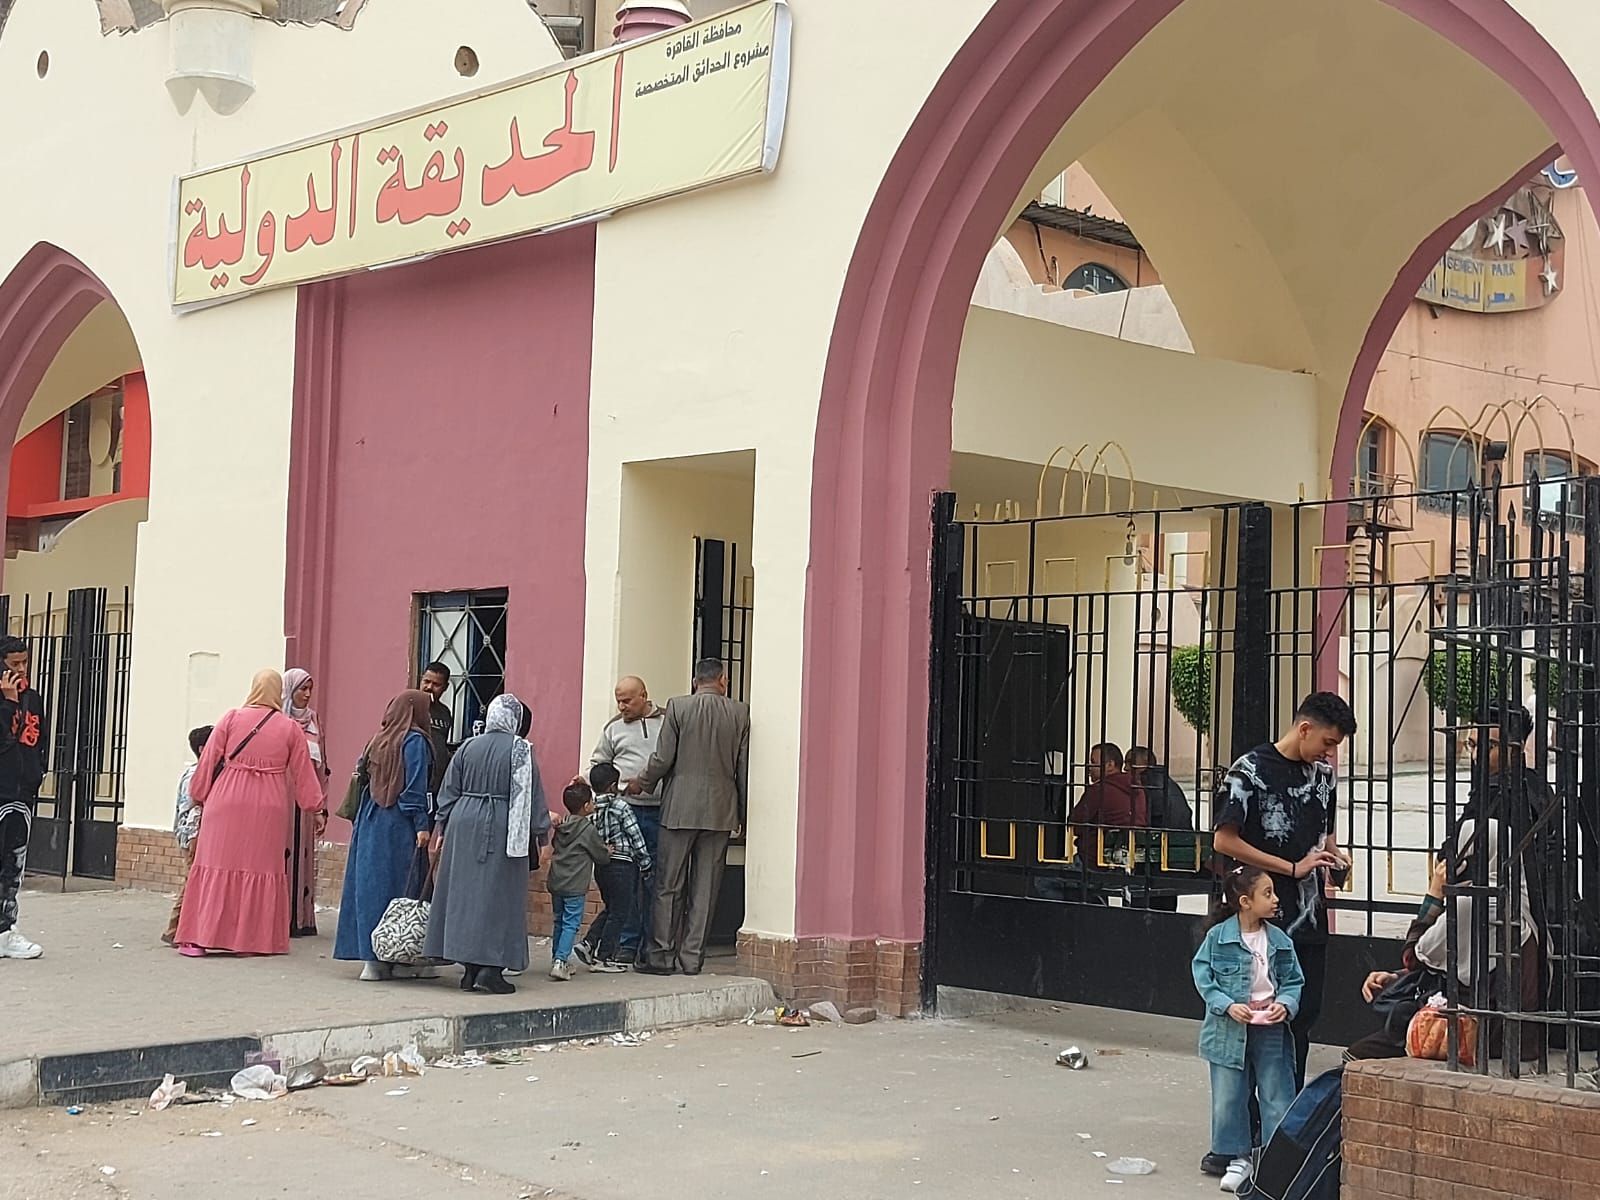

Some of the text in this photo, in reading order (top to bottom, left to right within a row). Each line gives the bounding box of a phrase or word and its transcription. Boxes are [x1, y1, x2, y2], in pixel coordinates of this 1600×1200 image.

[666, 20, 742, 60] محافظة القاهرة
[635, 43, 770, 98] مشروع الحدائق المتخصصة
[183, 51, 624, 291] الحديقة الدولية
[1491, 263, 1515, 277] PARK
